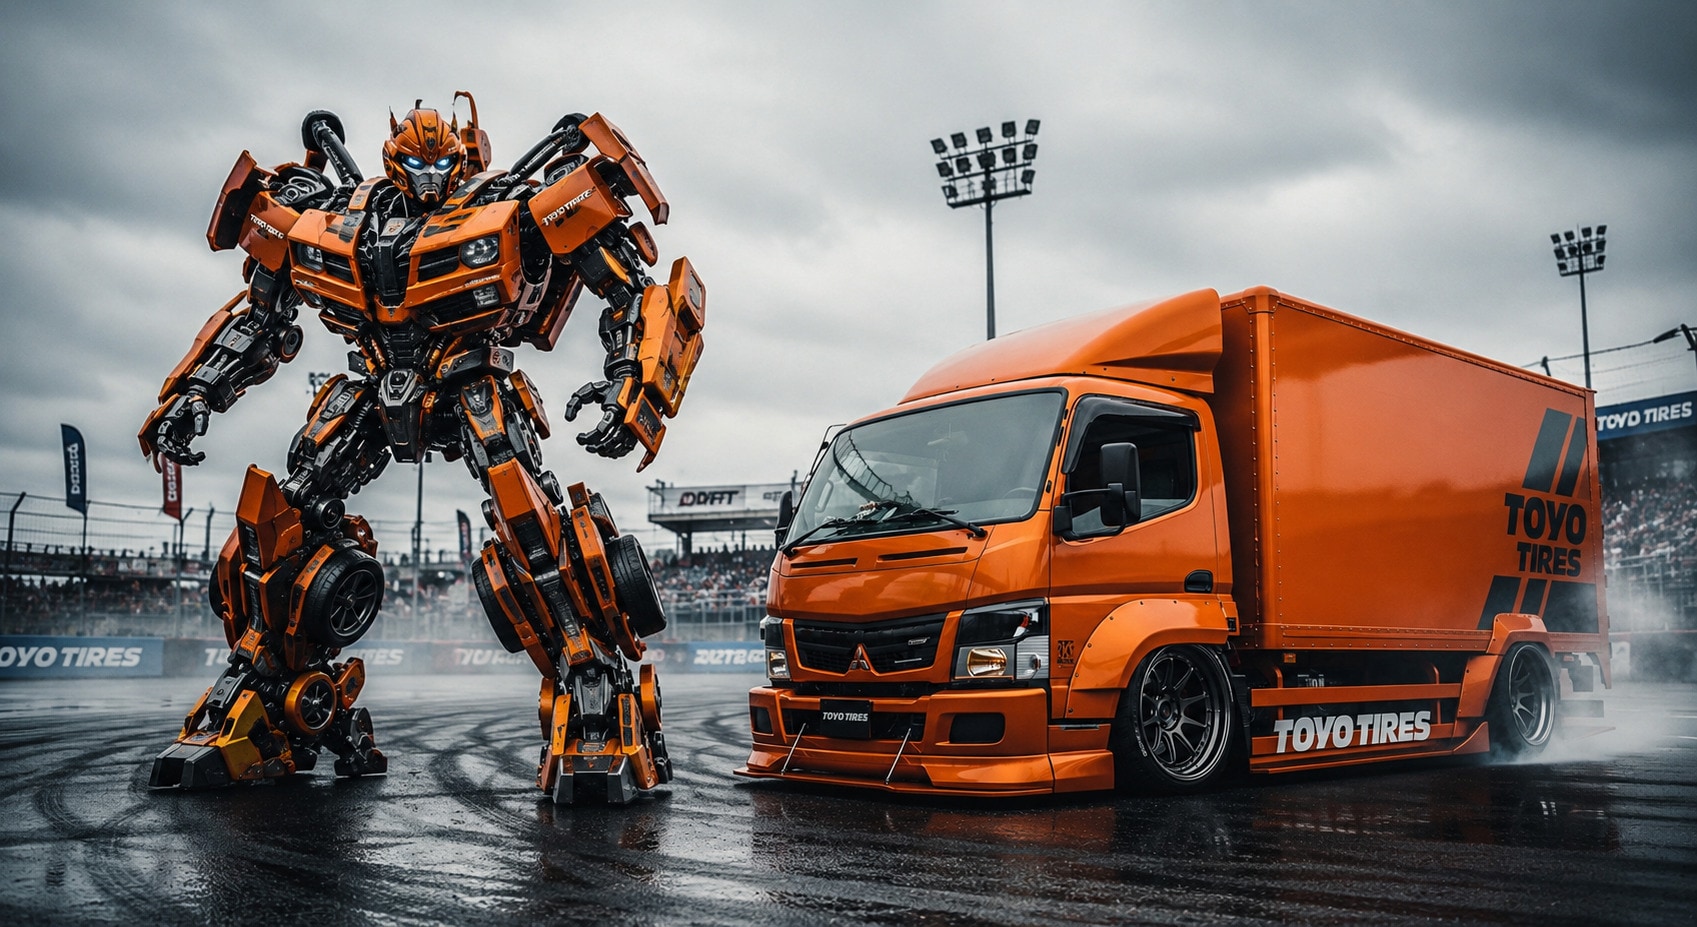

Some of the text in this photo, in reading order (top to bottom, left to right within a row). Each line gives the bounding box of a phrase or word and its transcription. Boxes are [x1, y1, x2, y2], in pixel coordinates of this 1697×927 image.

[1643, 401, 1693, 424] TIRES
[1504, 492, 1587, 546] TOYO
[1517, 541, 1582, 577] TIRES
[61, 647, 143, 667] TIRES
[822, 711, 869, 722] TOYO TIRES
[1273, 710, 1431, 754] TOYO TIRES
